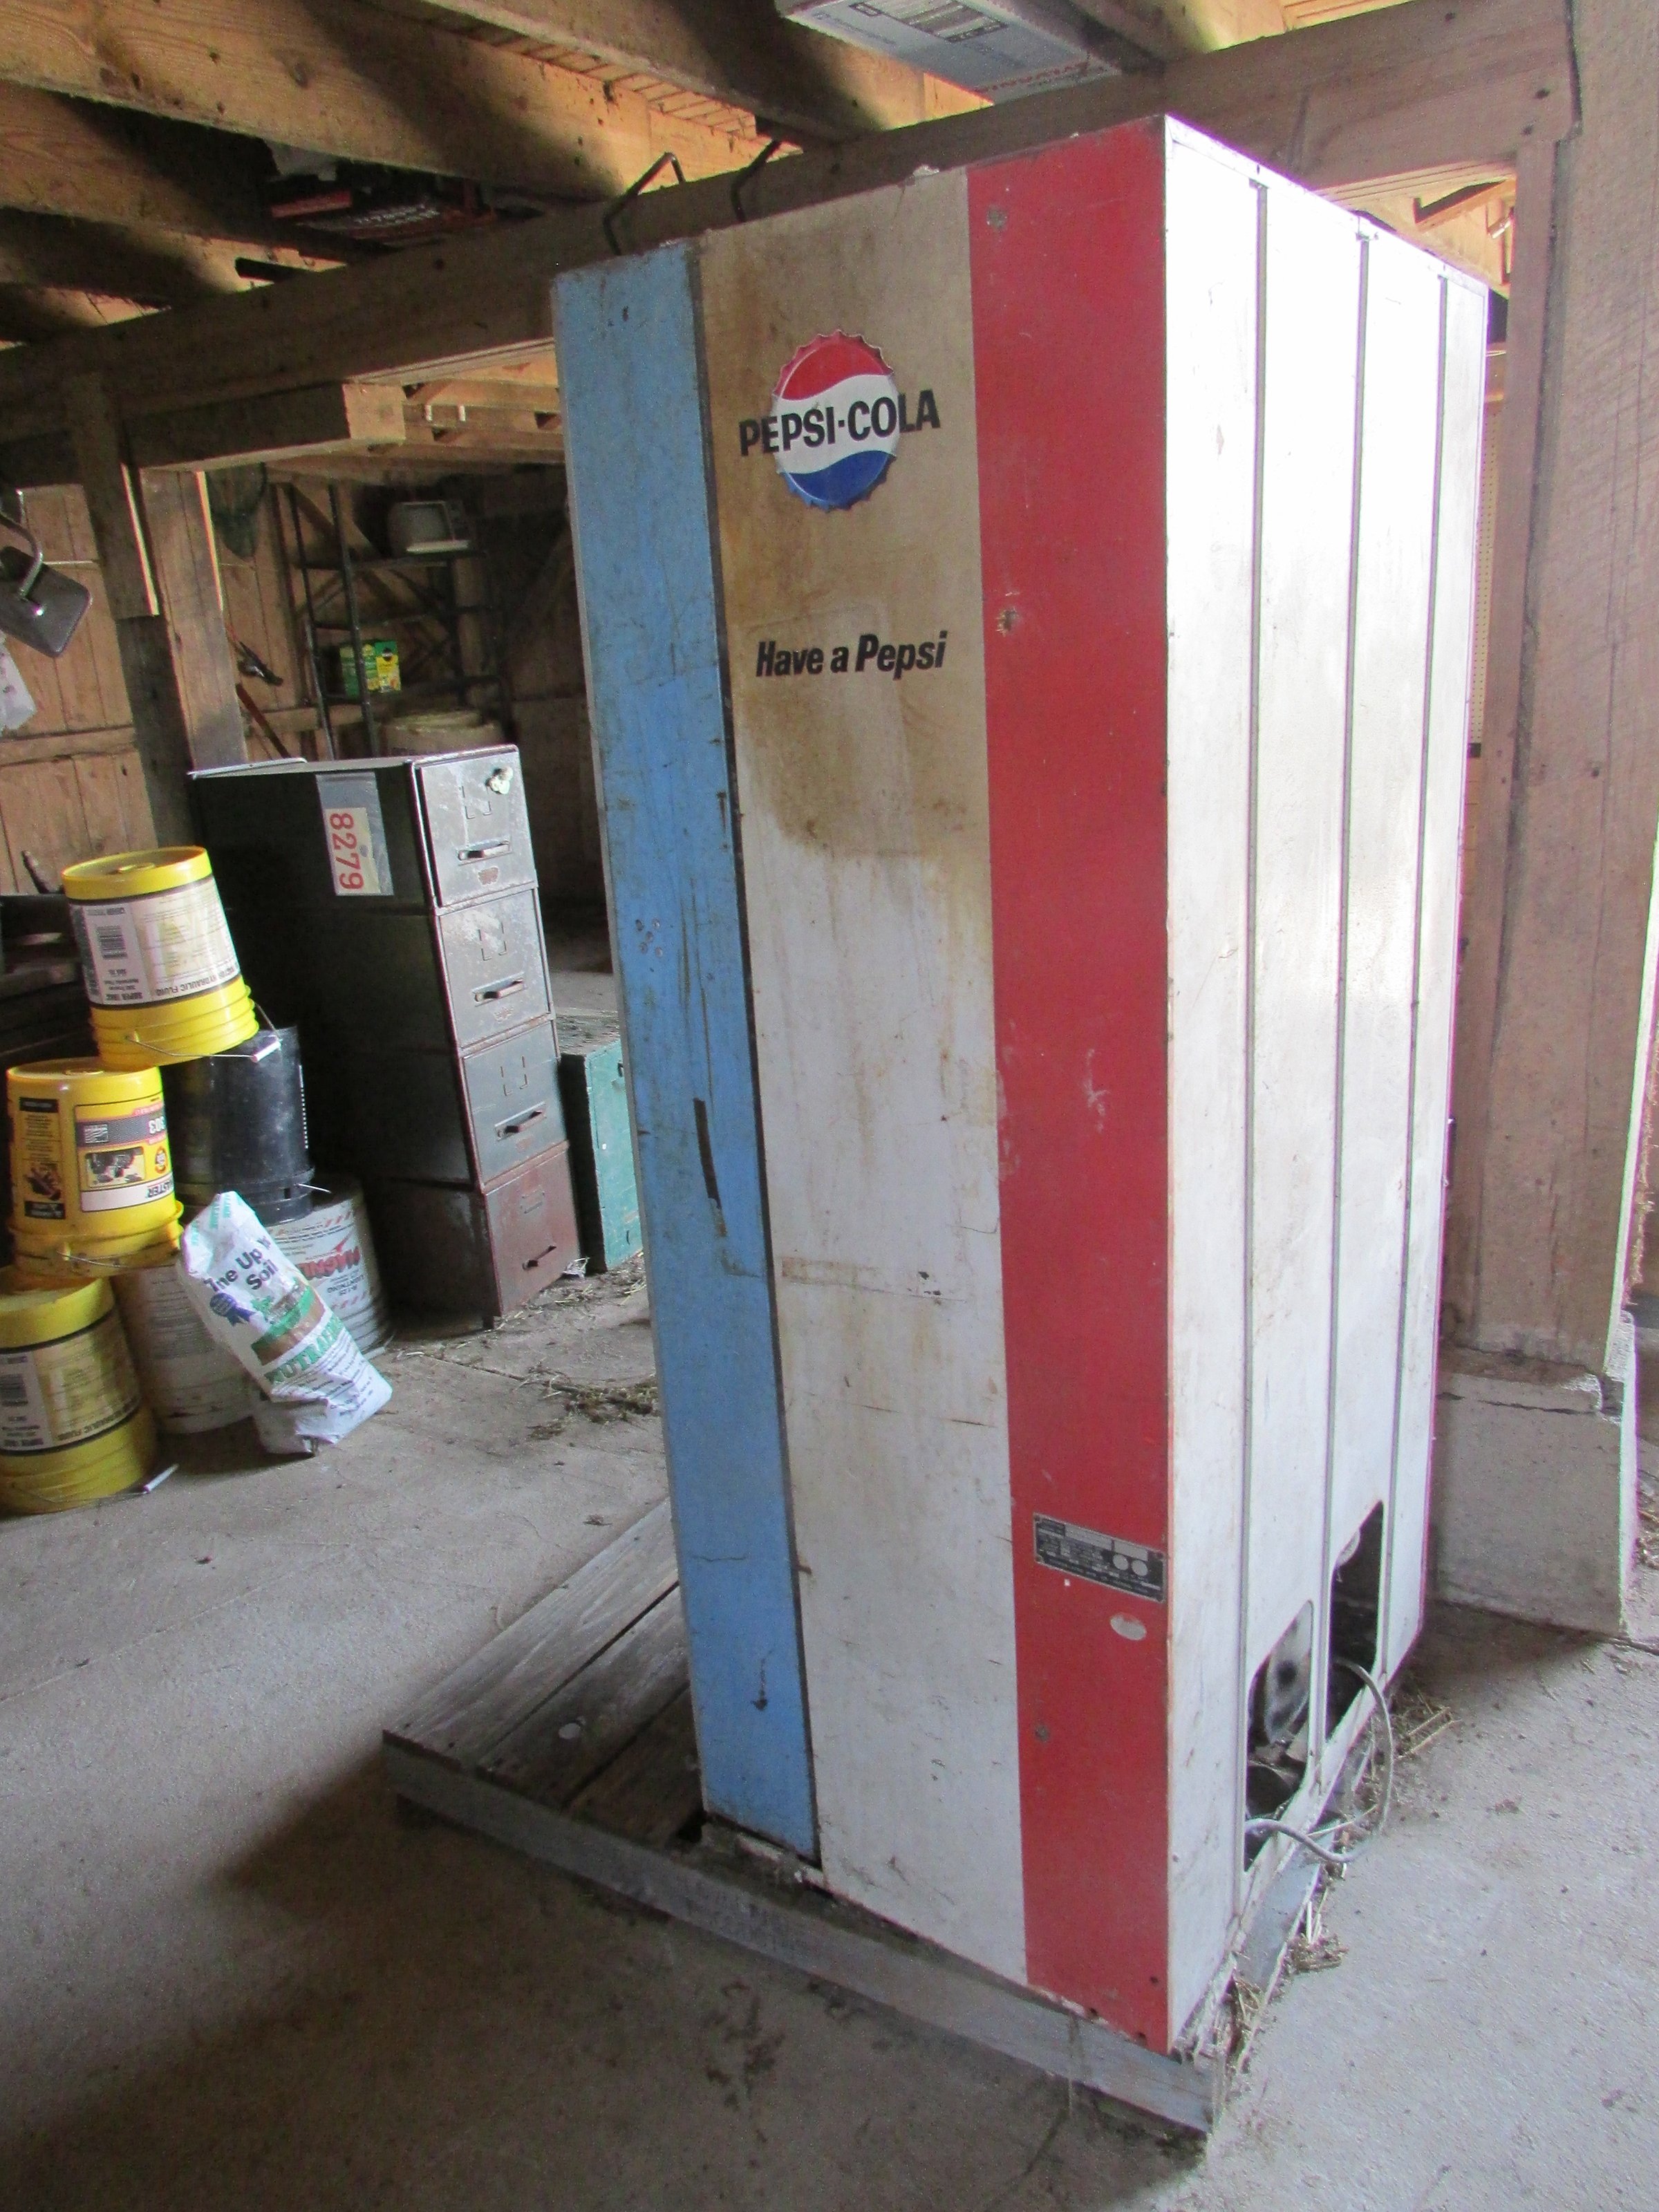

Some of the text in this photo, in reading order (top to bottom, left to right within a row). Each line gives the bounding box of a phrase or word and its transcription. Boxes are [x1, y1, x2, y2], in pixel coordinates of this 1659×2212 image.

[738, 388, 941, 456] PEPSI-COLA
[756, 630, 948, 680] Have a Pepsi
[330, 813, 364, 890] 8279
[235, 1248, 263, 1270] Up
[246, 1259, 279, 1291] Soil
